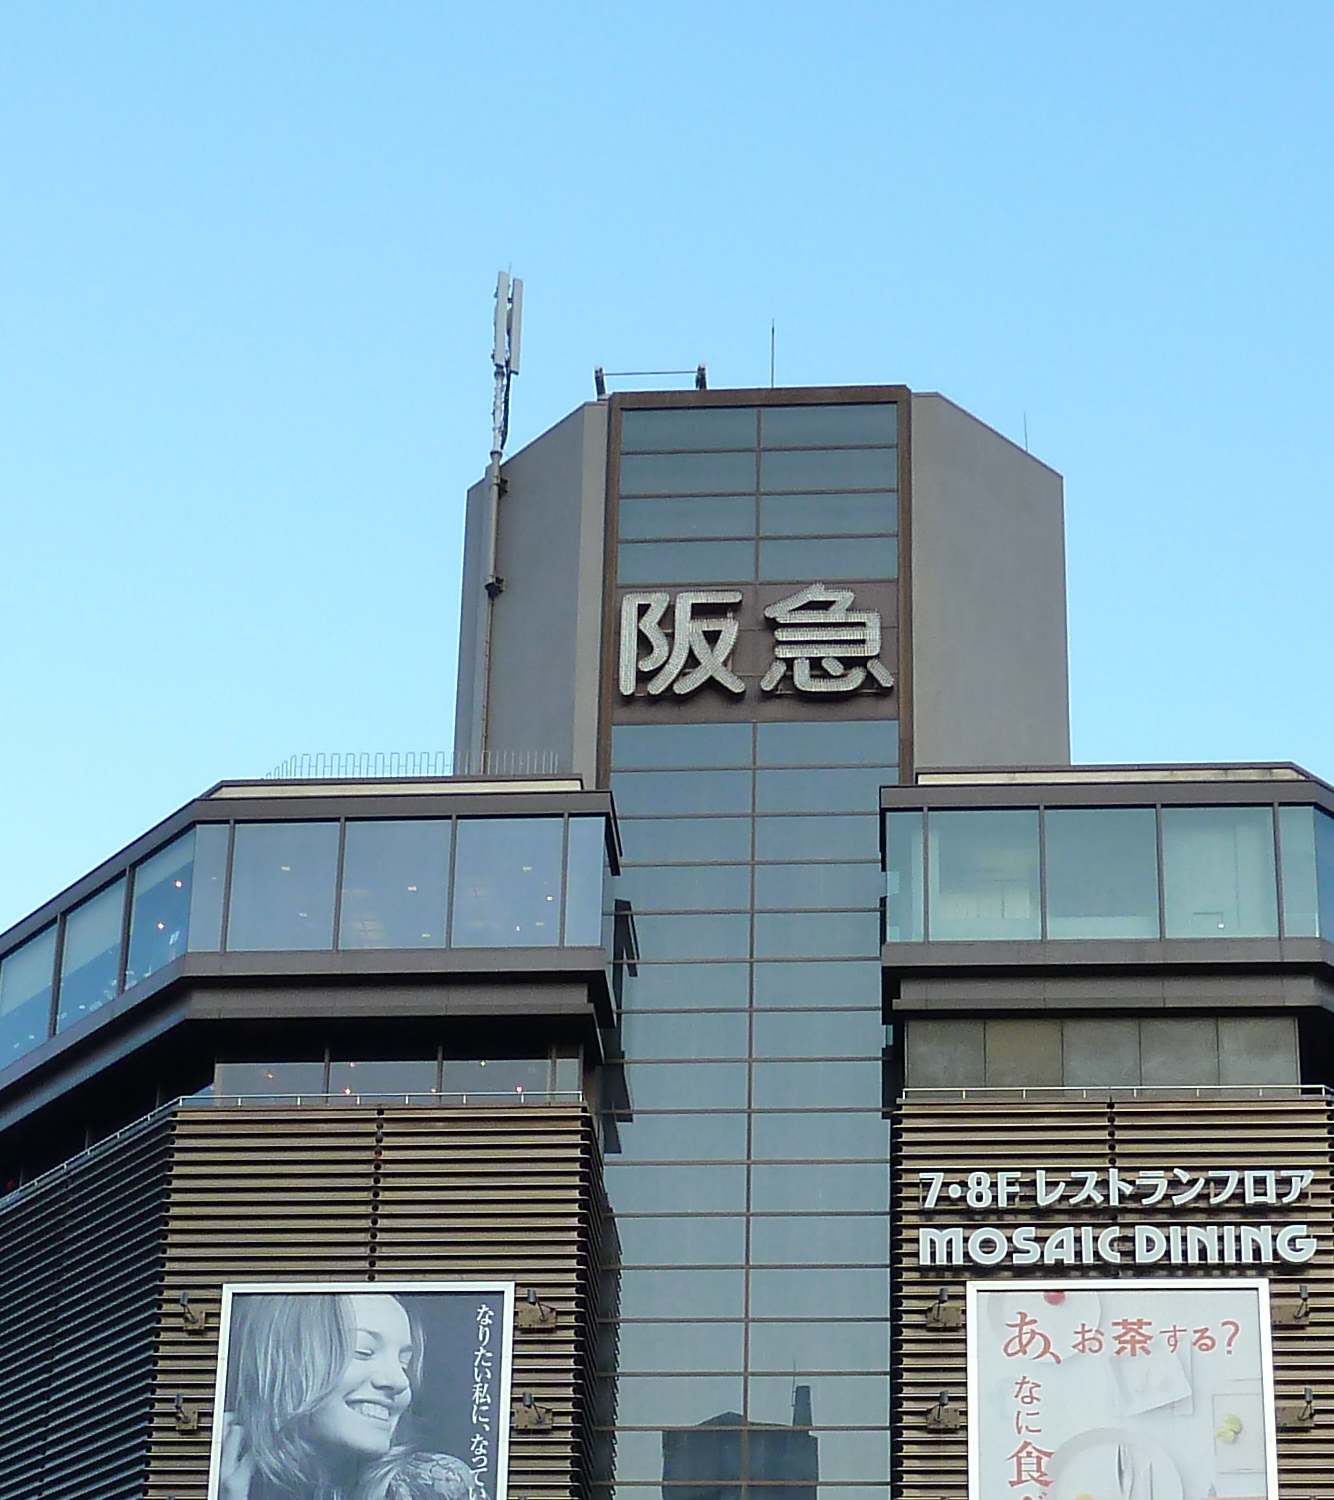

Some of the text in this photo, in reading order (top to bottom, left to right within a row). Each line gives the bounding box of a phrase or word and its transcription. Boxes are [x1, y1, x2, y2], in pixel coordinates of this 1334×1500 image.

[619, 582, 895, 696] 阪急
[1035, 1168, 1315, 1207] レストランフロア
[918, 1225, 1317, 1265] MOSAIC DINING
[1001, 1311, 1242, 1365] あ、お茶する？
